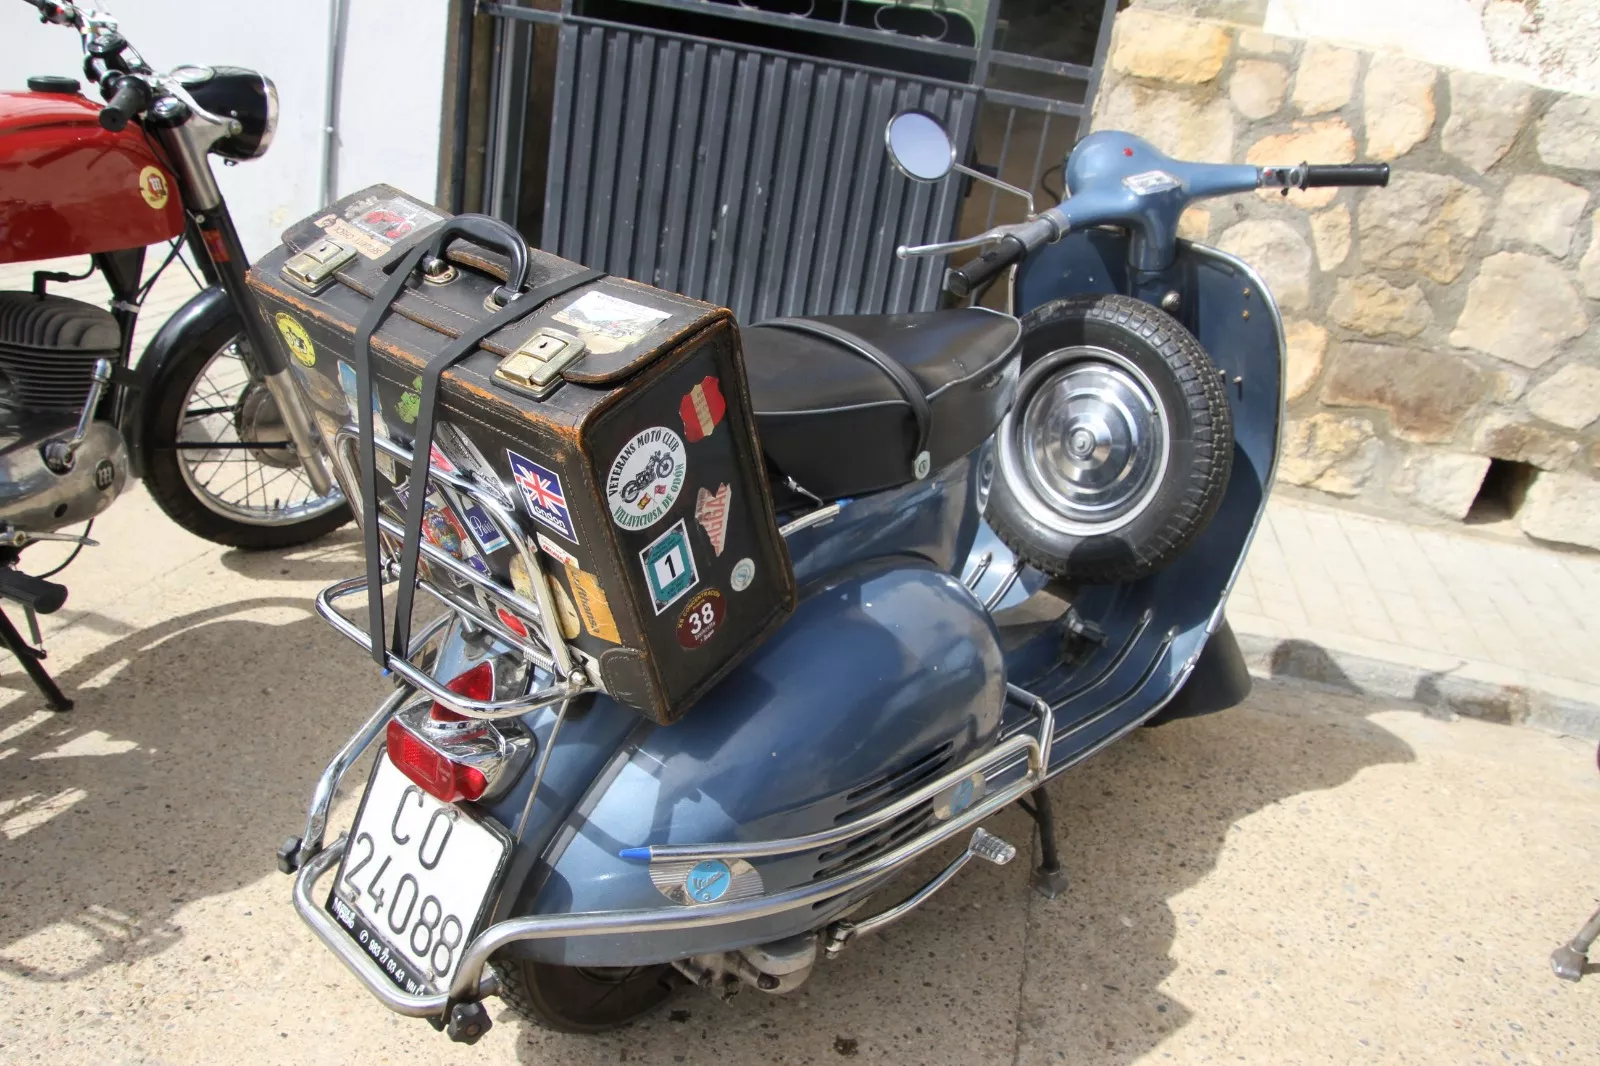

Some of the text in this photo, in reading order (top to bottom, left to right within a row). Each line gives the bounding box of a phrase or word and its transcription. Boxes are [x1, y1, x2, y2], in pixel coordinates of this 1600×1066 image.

[609, 430, 680, 497] VETERANS MOTO CLUB
[662, 493, 674, 509] DE
[469, 515, 496, 537] Paris
[664, 554, 677, 579] 1
[689, 602, 714, 634] 38
[391, 784, 455, 870] CO
[344, 832, 463, 978] 24088
[368, 939, 382, 957] 983
[380, 948, 389, 964] 27
[387, 959, 397, 974] 03
[395, 966, 405, 983] 43
